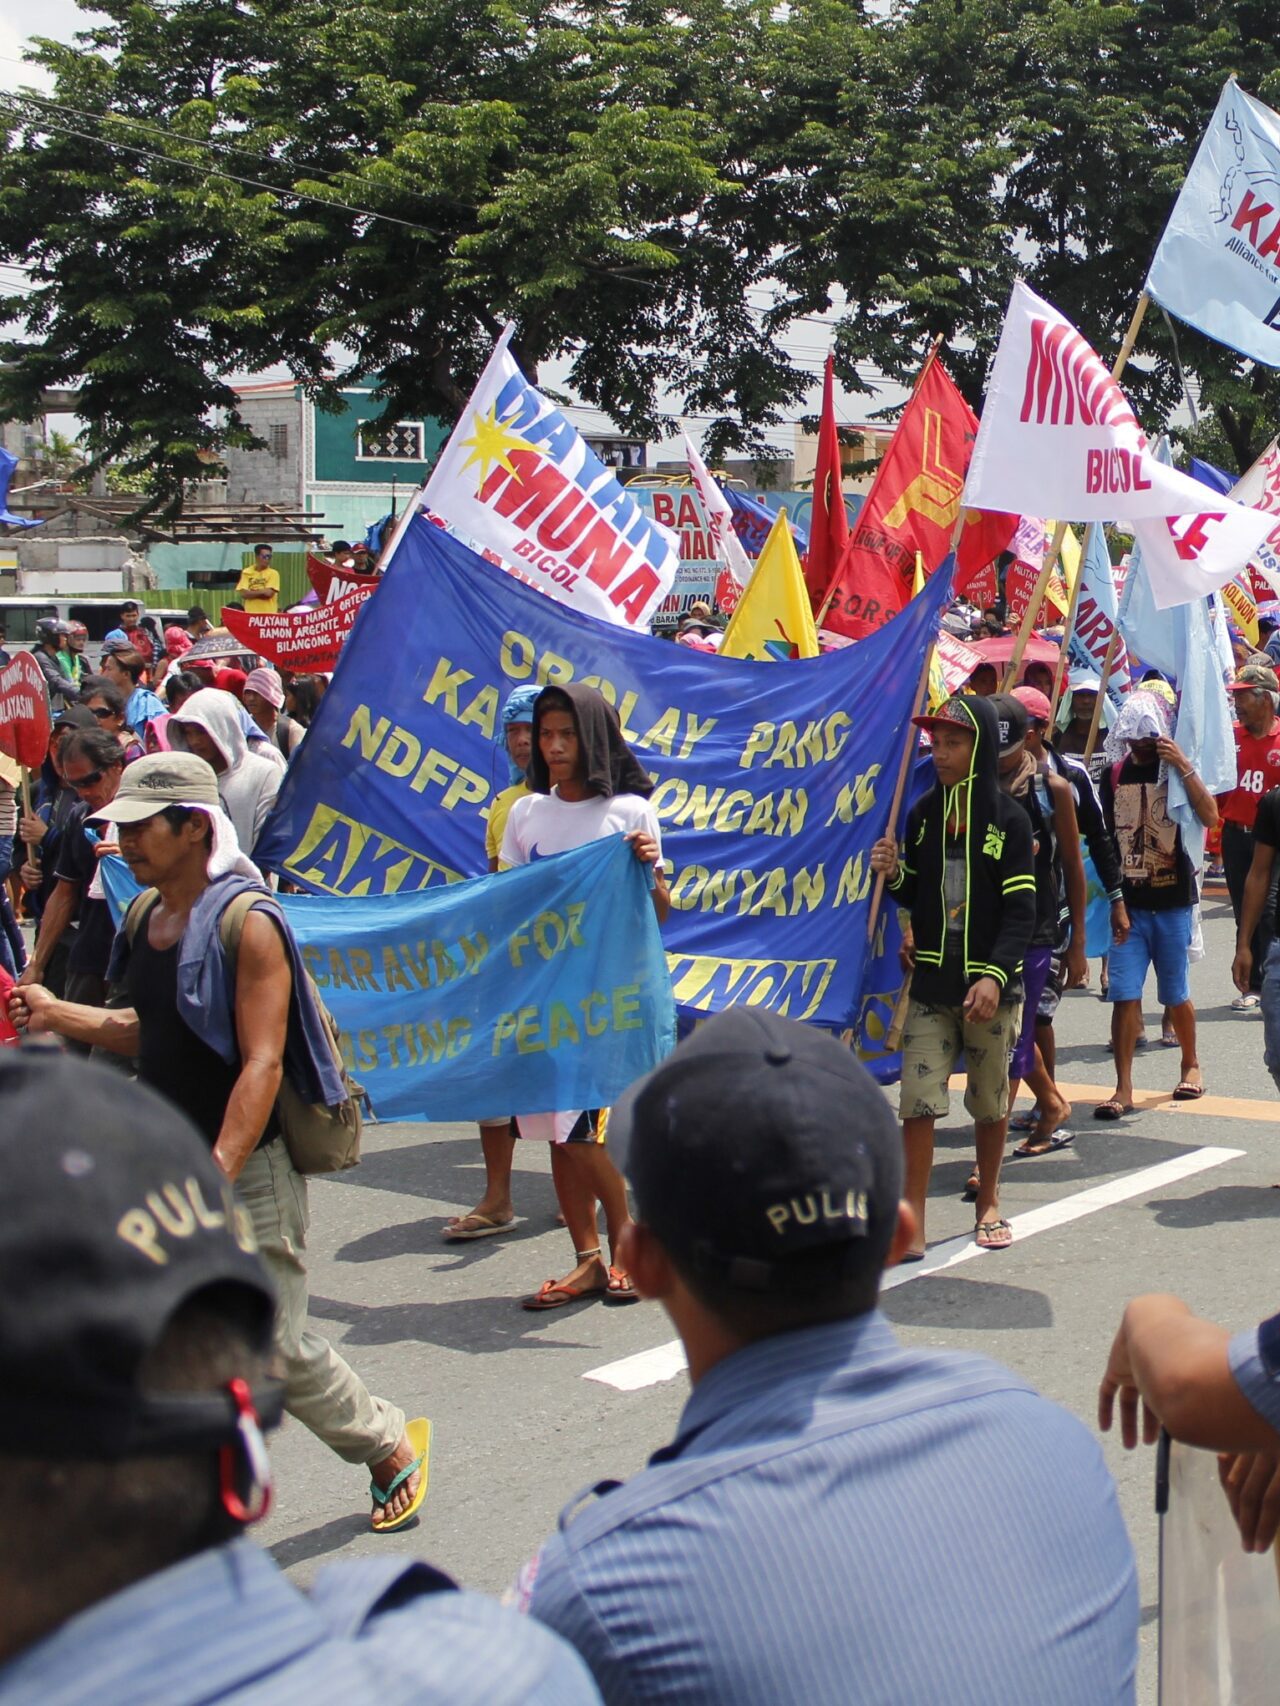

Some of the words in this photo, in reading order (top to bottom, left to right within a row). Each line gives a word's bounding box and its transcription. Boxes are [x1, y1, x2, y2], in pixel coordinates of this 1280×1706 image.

[652, 492, 702, 528] BA
[473, 448, 661, 625] MUNA
[512, 538, 582, 593] BICOL
[248, 616, 289, 628] PALAYAIN
[293, 618, 302, 626] SI
[306, 605, 335, 624] NANCY
[339, 589, 372, 611] ORTEGA
[259, 627, 292, 639] RAMON
[295, 617, 340, 639] ARGENTE
[344, 609, 356, 624] AT
[276, 634, 332, 654] BILANGONG
[739, 710, 853, 769] PANG
[1239, 769, 1265, 794] 48
[982, 833, 1004, 861] 23
[305, 930, 489, 993] CARAVAN
[508, 901, 586, 968] FOR
[491, 983, 644, 1056] PEACE
